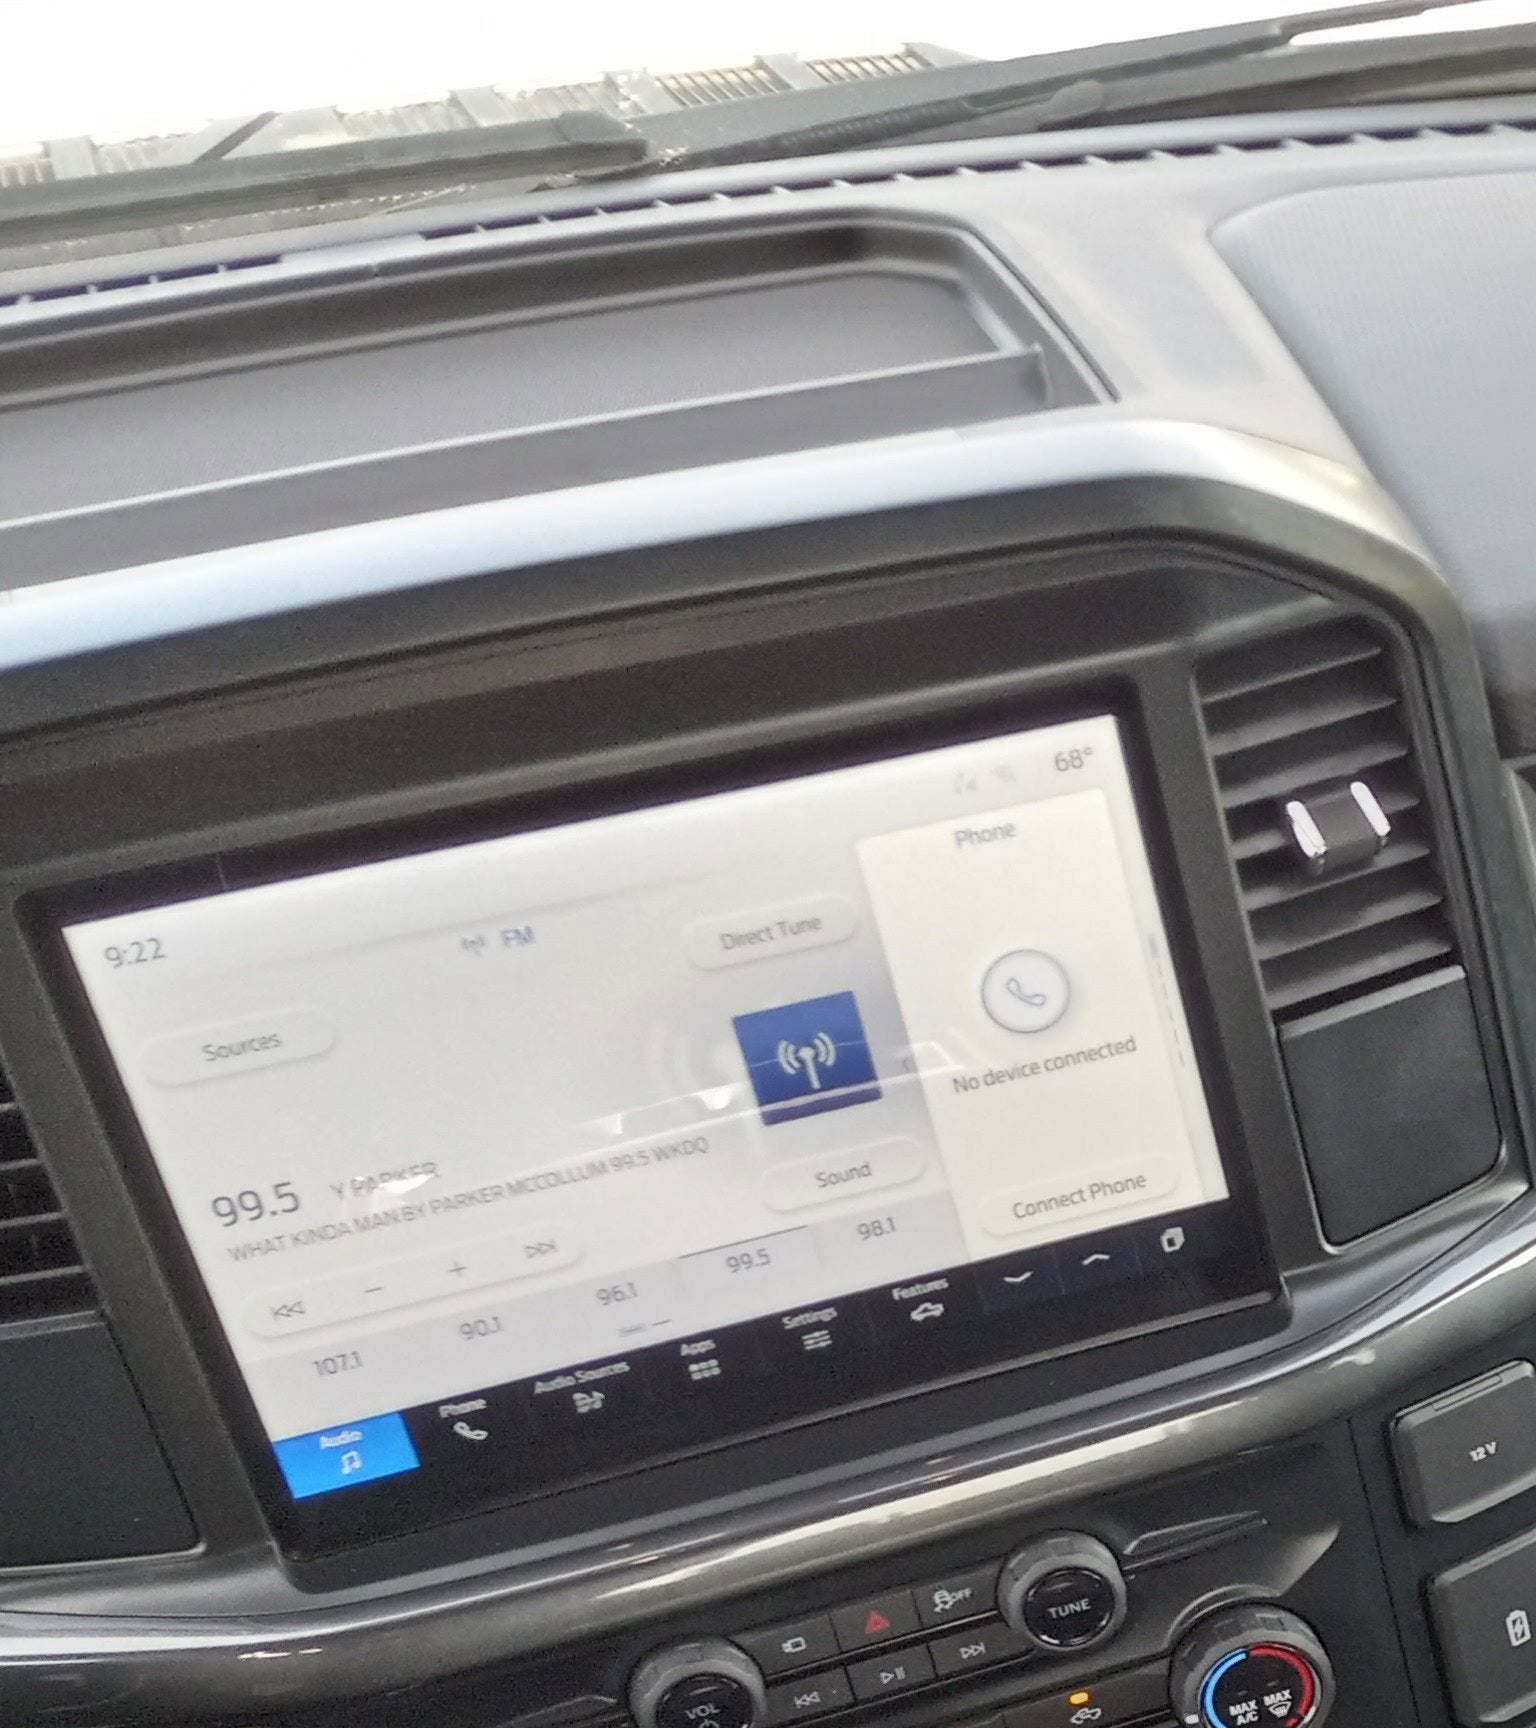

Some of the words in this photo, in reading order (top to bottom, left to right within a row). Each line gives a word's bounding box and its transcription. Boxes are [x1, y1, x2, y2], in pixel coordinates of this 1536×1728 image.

[953, 820, 1018, 851] Phone
[501, 925, 538, 949] FM
[721, 923, 775, 953] Direct
[776, 913, 824, 941] Tune
[103, 936, 167, 970] 9:22
[201, 1031, 283, 1063] Sources
[952, 1076, 980, 1096] No
[982, 1059, 1041, 1091] device
[1042, 1035, 1138, 1077] connected
[814, 1159, 873, 1190] Sound
[210, 1180, 302, 1228] 99.5
[227, 1234, 286, 1262] WHAT
[290, 1222, 352, 1248] KINDA
[352, 1209, 402, 1233] MAN
[400, 1203, 427, 1223] BY
[430, 1184, 506, 1216] PARKER
[504, 1159, 608, 1197] MCCOLLUM
[607, 1147, 651, 1174] 99.5
[650, 1135, 711, 1163] WKDQ
[1011, 1184, 1087, 1221] Connect
[1089, 1170, 1149, 1203] Phone
[311, 1348, 363, 1378] 107.1
[458, 1315, 506, 1342] 90.1
[595, 1281, 639, 1307] 96.1
[725, 1248, 773, 1275] 99.5
[856, 1216, 898, 1243] 98.1
[891, 1276, 951, 1302] Features
[782, 1304, 839, 1332] Settings
[318, 1428, 364, 1451] Audio
[1047, 1597, 1092, 1621] TUNE
[685, 1702, 719, 1721] VOL
[1228, 1699, 1259, 1718] MAX
[1262, 1688, 1293, 1707] MAX
[1235, 1711, 1261, 1727] A/C
